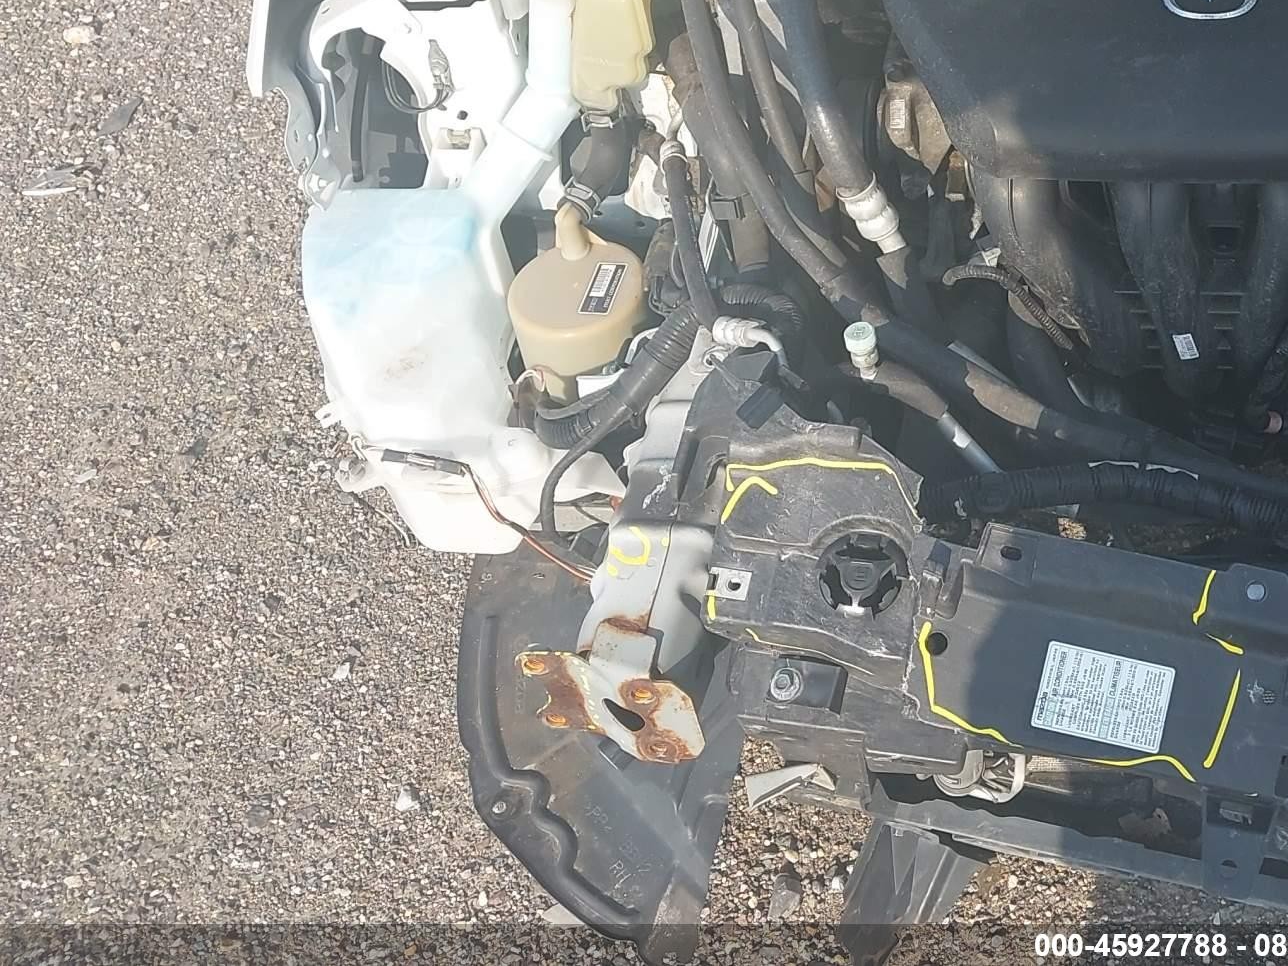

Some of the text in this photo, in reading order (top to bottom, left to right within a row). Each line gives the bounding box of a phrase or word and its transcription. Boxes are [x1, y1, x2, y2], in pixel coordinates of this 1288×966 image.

[1053, 651, 1068, 687] CONDITIONER
[1108, 661, 1123, 697] CLIMATISEUR
[1036, 690, 1049, 721] mazda
[1051, 687, 1059, 697] AIR
